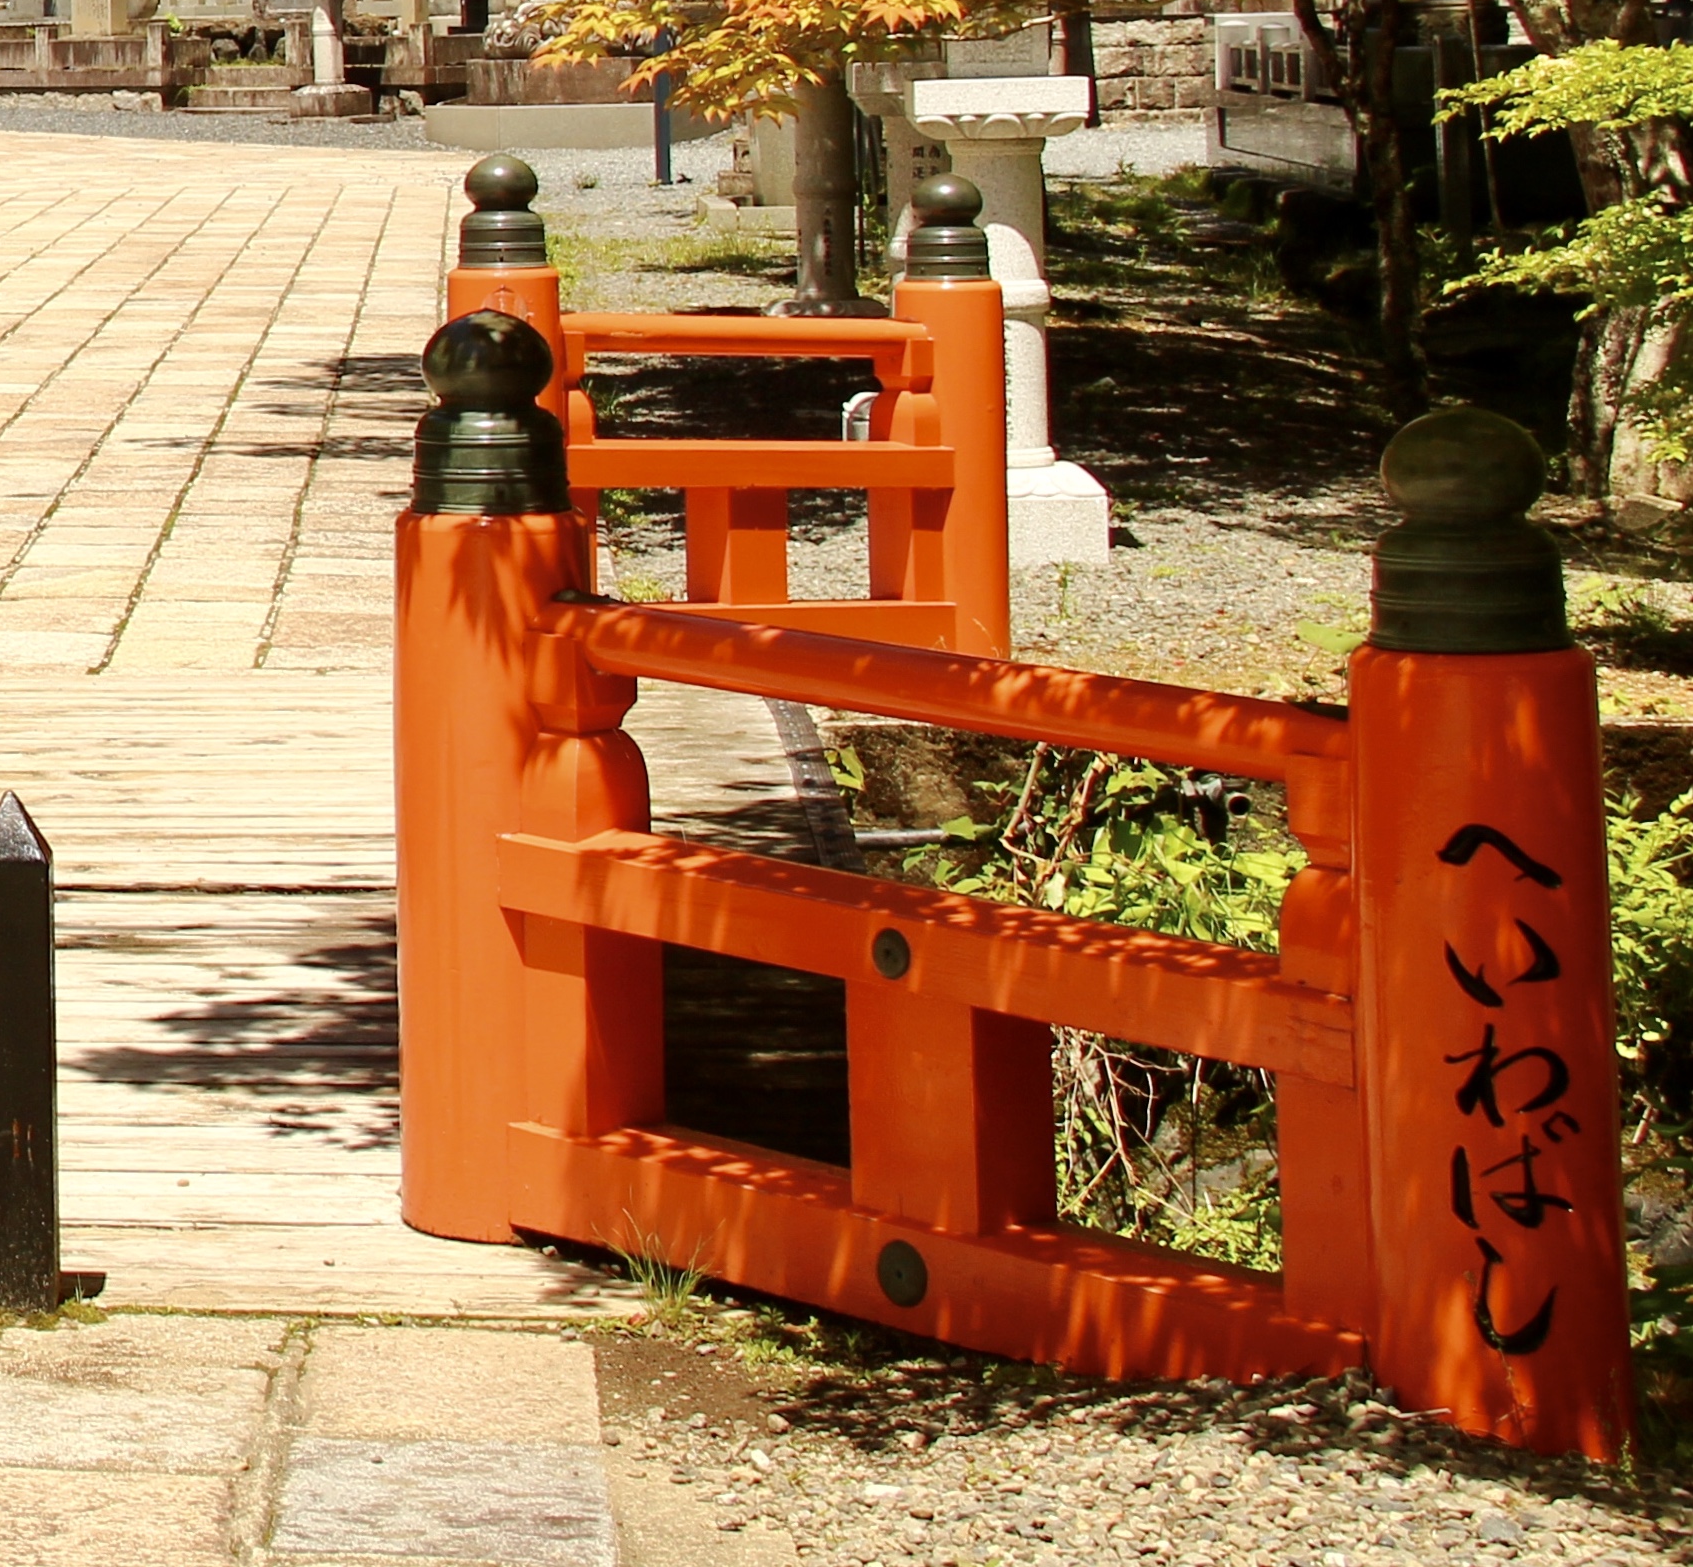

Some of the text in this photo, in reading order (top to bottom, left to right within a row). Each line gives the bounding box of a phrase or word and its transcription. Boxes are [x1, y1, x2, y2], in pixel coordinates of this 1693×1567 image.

[1435, 822, 1580, 1357] へいわばし
